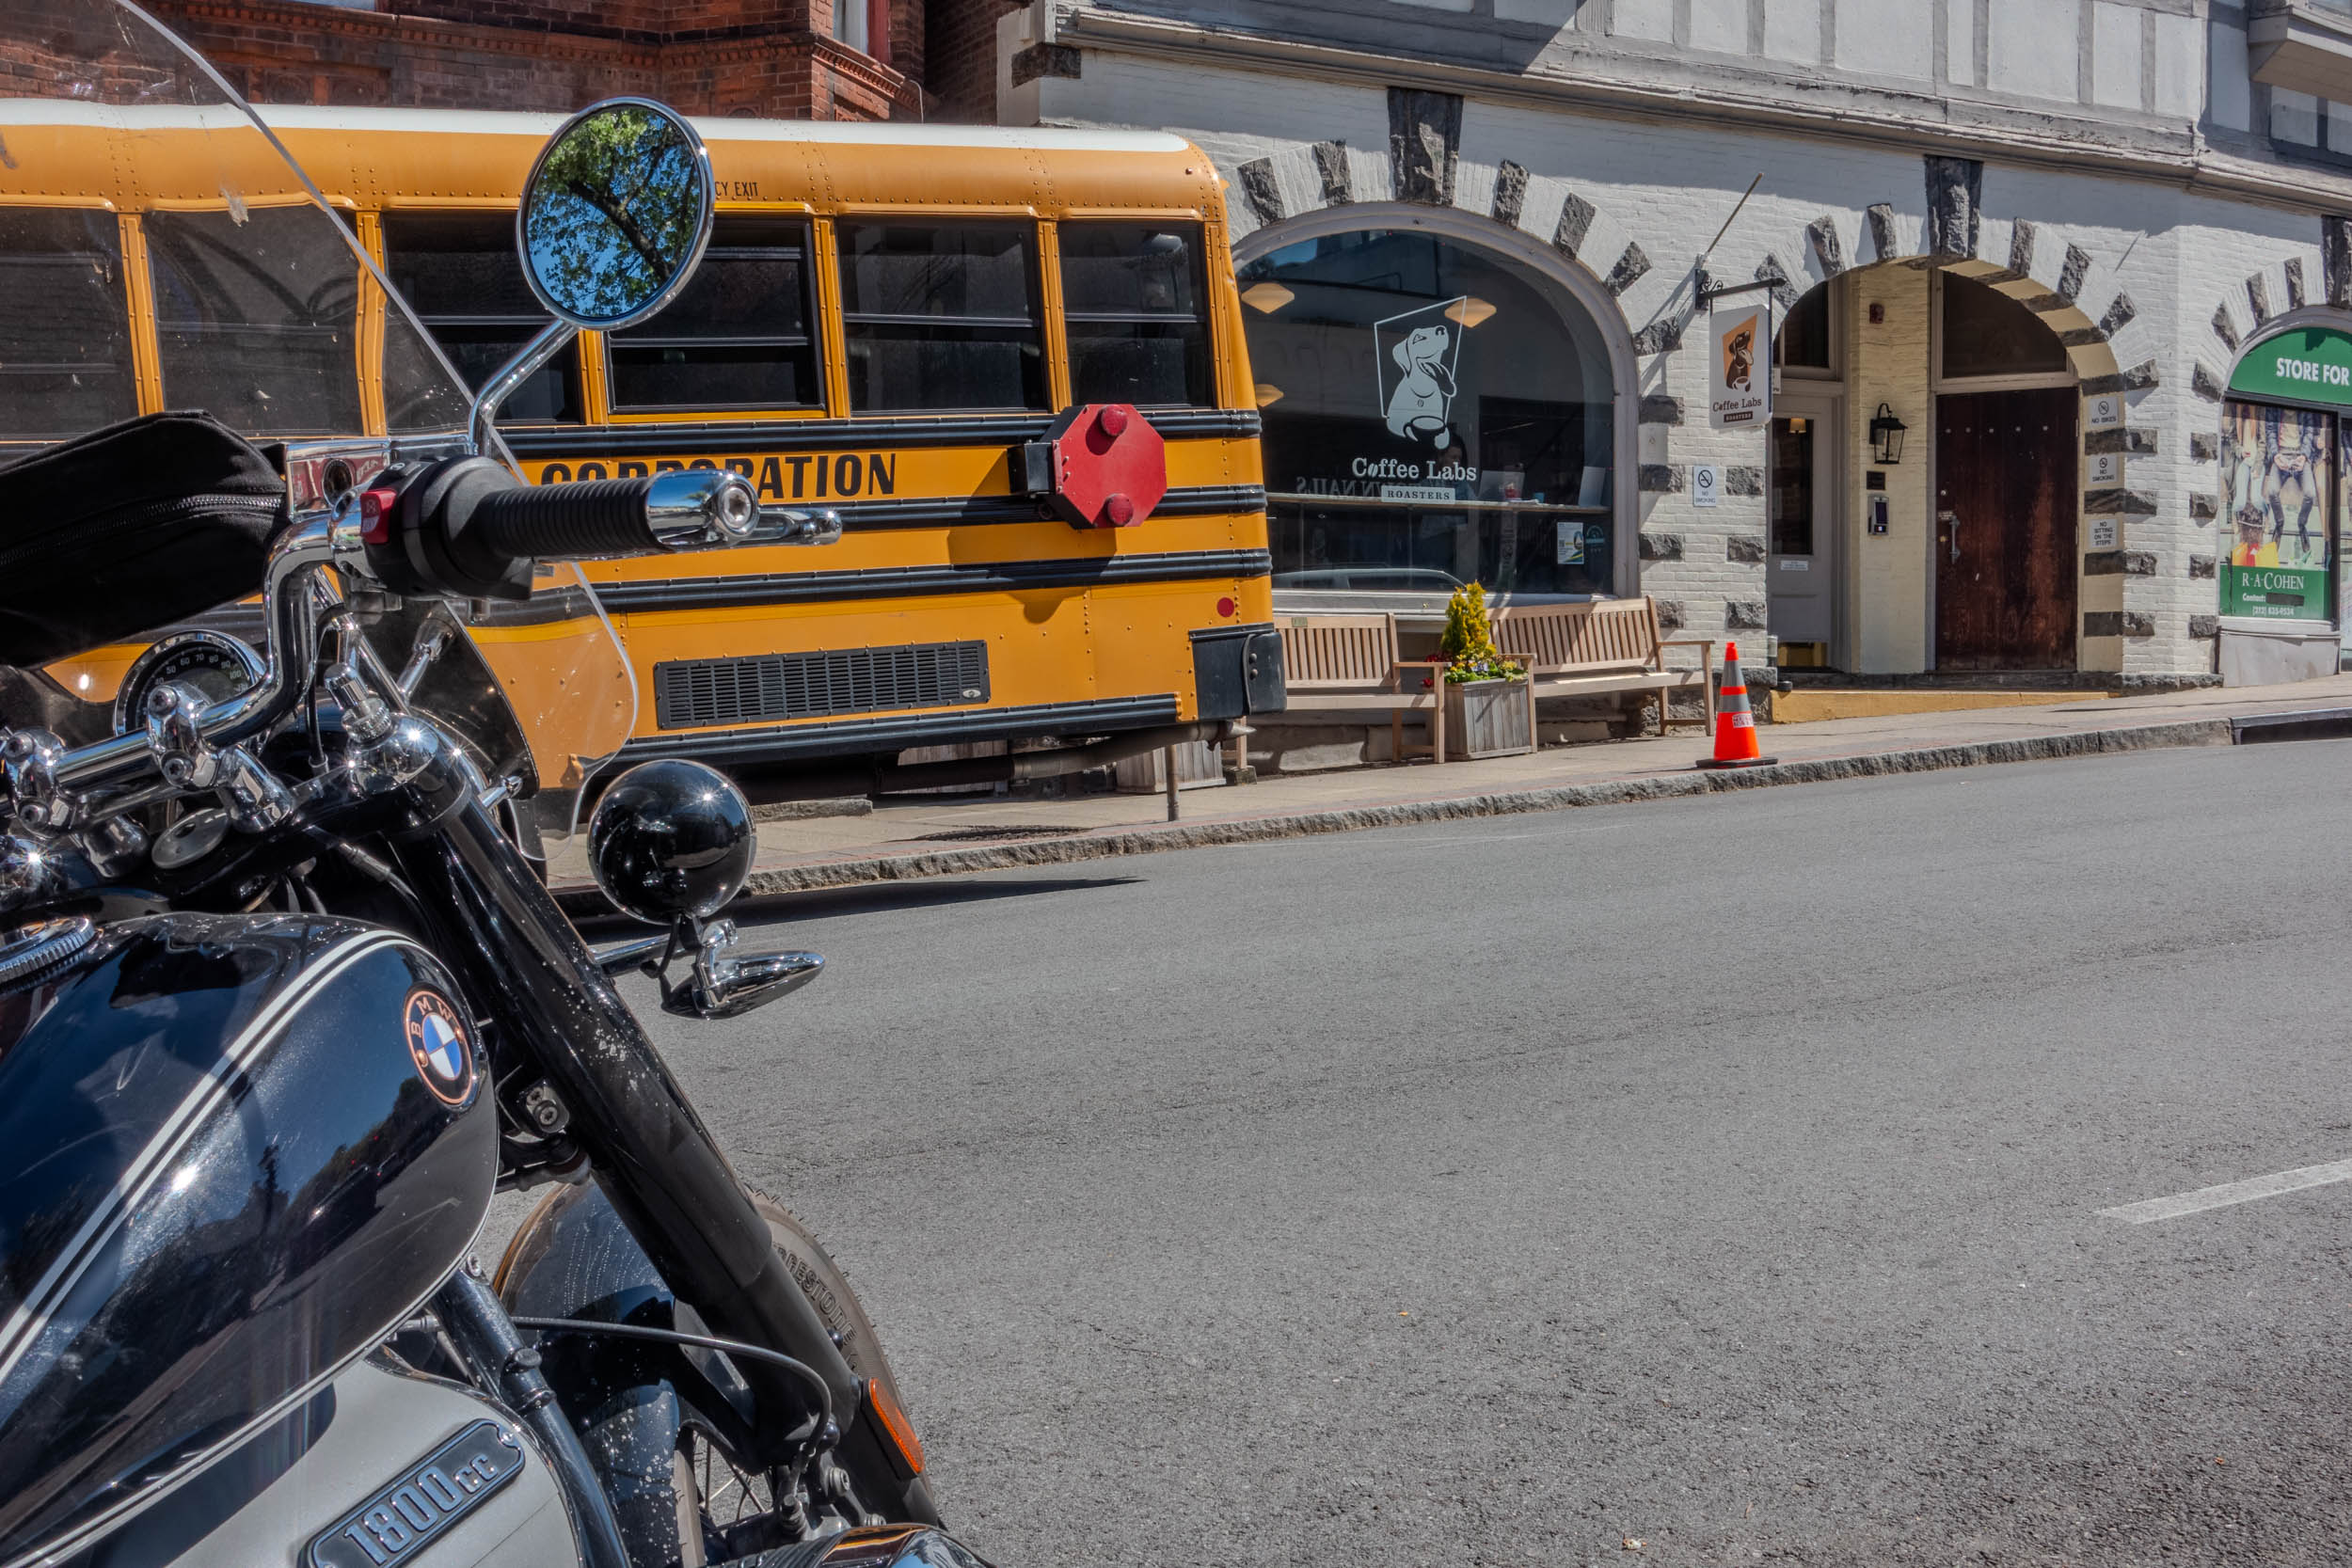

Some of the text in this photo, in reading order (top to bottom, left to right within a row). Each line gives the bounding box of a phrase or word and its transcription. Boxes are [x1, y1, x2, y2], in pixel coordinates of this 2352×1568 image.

[734, 182, 758, 197] EXIT
[2276, 357, 2350, 387] STORE FOR
[1712, 398, 1762, 412] Coffee Labs
[1352, 457, 1477, 481] Coffee Labs
[1387, 490, 1451, 500] ROASTERS
[209, 655, 219, 663] 80
[167, 665, 177, 674] 50
[411, 996, 453, 1038] BMW
[343, 1454, 499, 1565] 1800cc
